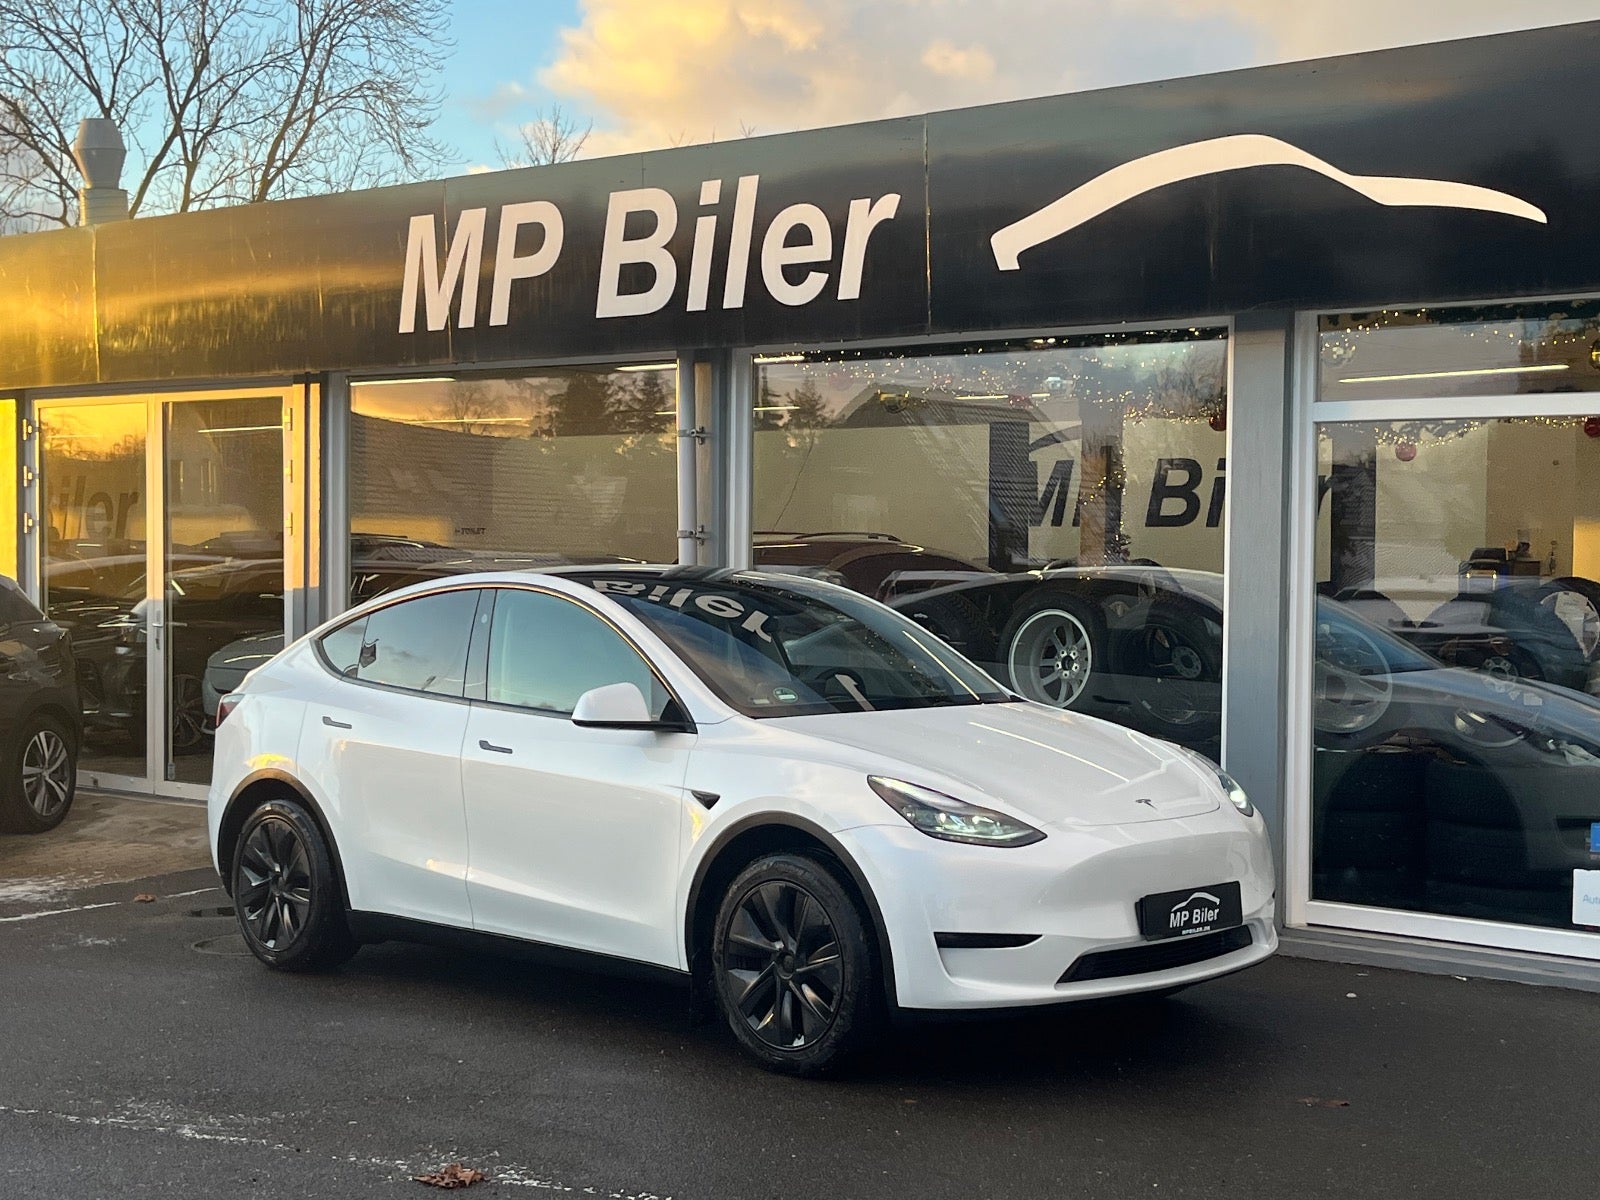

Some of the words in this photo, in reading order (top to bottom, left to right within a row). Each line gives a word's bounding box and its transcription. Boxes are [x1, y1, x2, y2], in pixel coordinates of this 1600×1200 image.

[399, 200, 565, 333] MP
[596, 174, 901, 318] Biler
[48, 474, 139, 540] iler
[1169, 910, 1190, 928] MP
[1192, 907, 1220, 924] Biler
